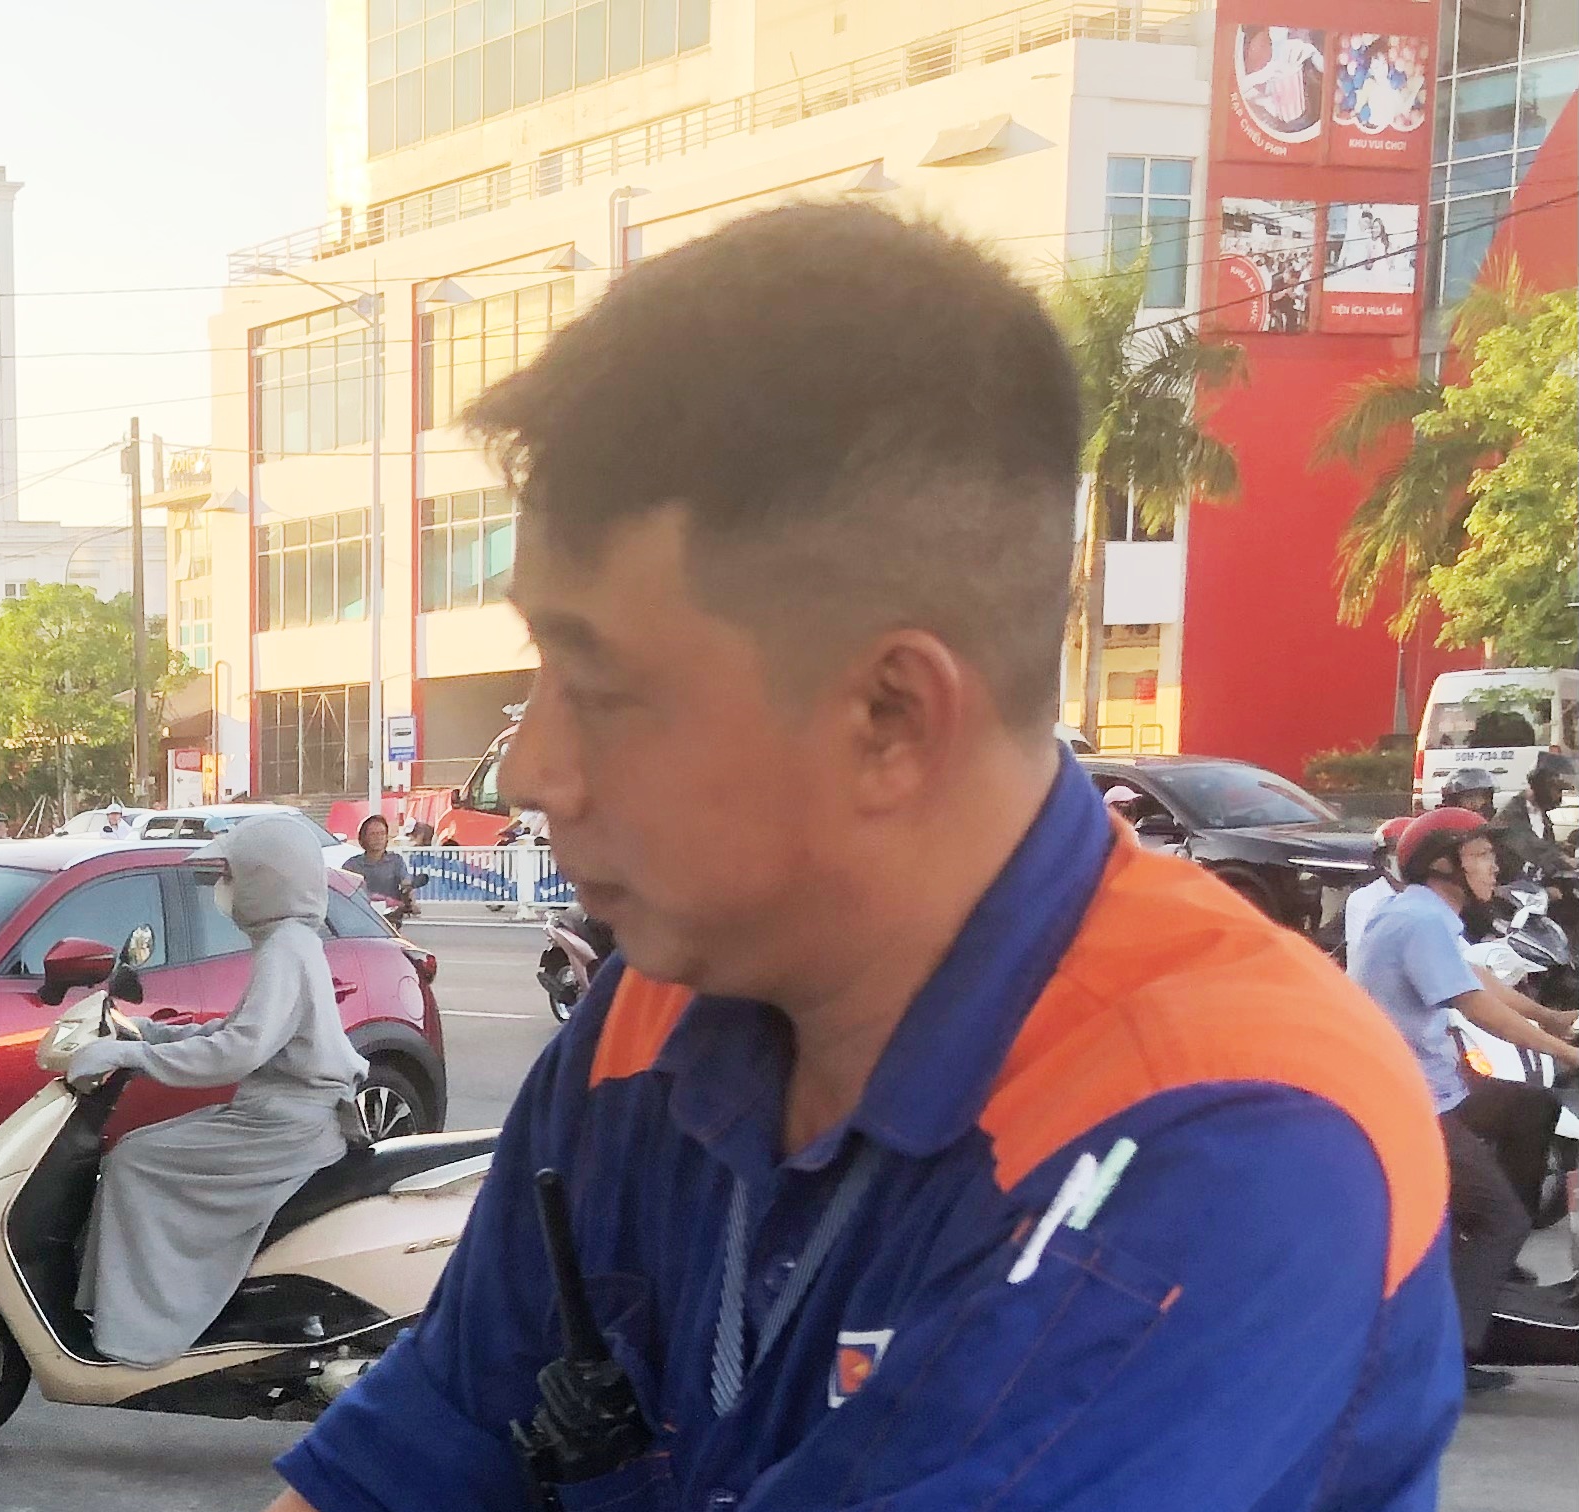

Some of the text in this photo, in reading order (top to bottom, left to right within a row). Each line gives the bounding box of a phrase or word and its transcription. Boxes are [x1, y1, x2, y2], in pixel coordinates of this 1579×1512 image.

[1348, 138, 1367, 149] KHU
[1368, 139, 1384, 150] VUI
[1230, 265, 1247, 279] KHU
[1366, 305, 1385, 315] MUA
